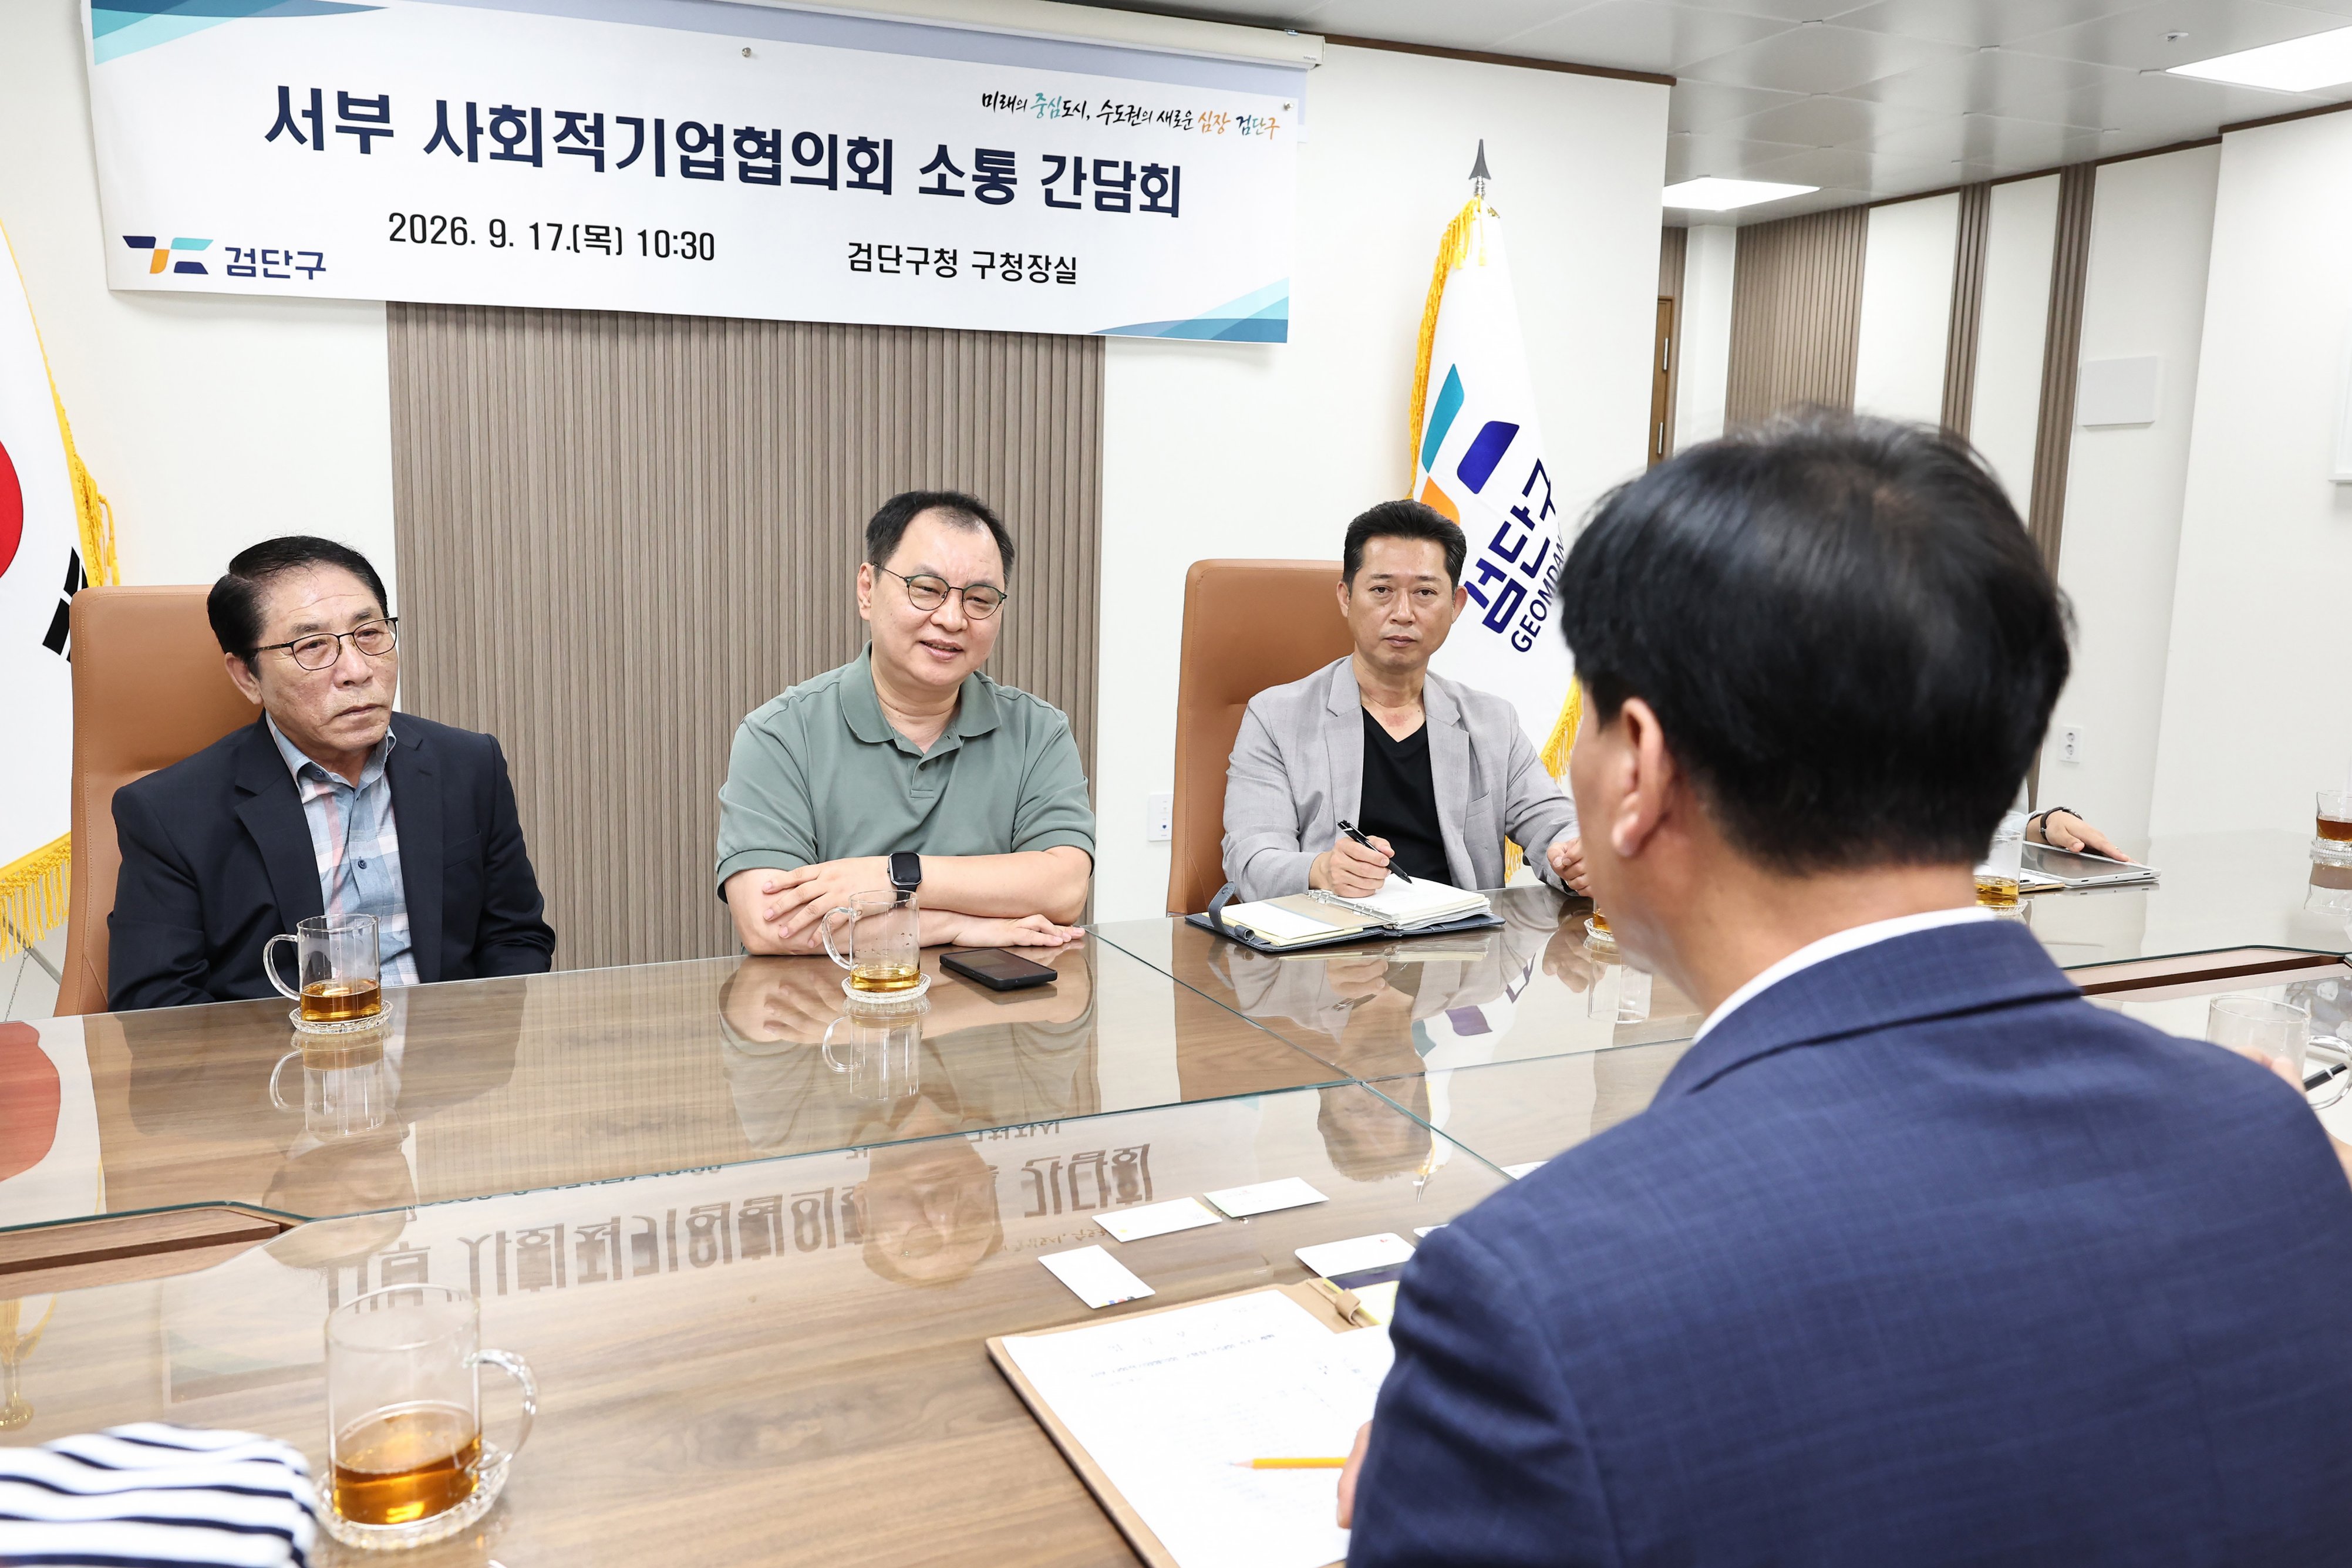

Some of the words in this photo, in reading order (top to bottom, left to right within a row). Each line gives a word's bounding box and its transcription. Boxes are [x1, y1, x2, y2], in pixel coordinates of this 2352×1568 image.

[982, 91, 1028, 113] 미래의
[1030, 92, 1090, 122] 중심도시,
[1096, 99, 1152, 126] 수도권의
[1157, 110, 1194, 131] 새로운
[1198, 110, 1231, 134] 심장
[1236, 115, 1281, 140] 검단구
[264, 85, 394, 155] 서부
[423, 99, 893, 195] 사회적기업협의회
[918, 144, 1017, 205] 소통
[1040, 154, 1181, 218] 간담회
[389, 212, 476, 246] 2026.
[489, 218, 514, 248] 9.
[529, 222, 622, 256] 17.(목)
[637, 229, 715, 261] 10:30
[225, 247, 326, 280] 검단구
[848, 242, 958, 278] 검단구청
[972, 251, 1076, 285] 구청장실
